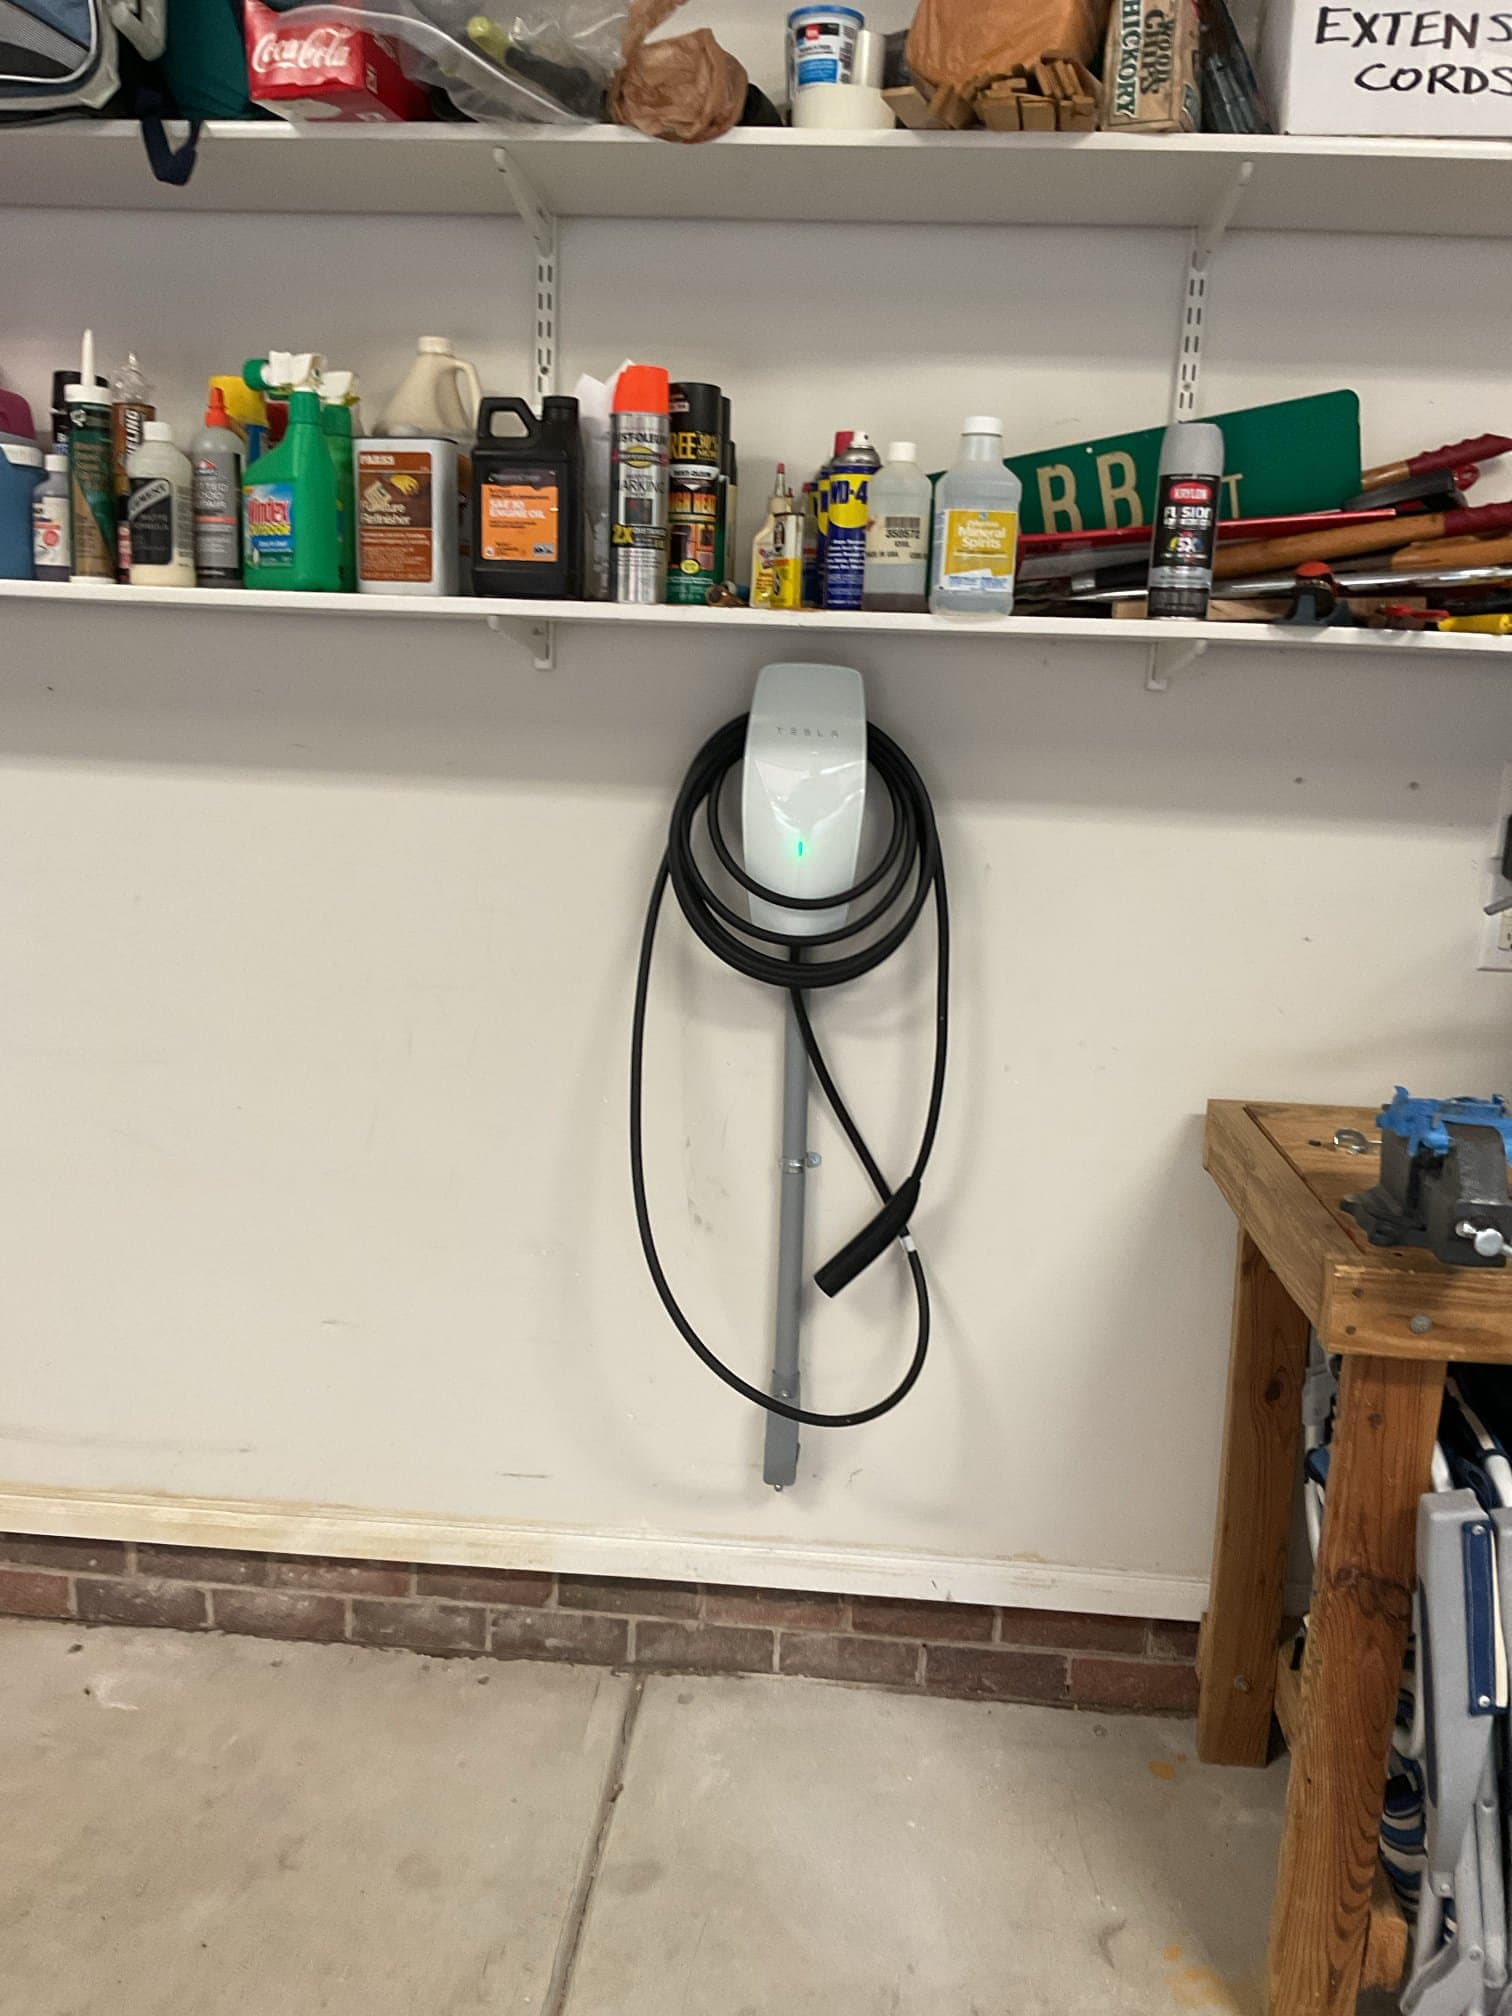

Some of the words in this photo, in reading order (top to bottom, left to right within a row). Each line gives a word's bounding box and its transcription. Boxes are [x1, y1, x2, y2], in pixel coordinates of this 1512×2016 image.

[252, 28, 352, 73] Coca-Cola
[1116, 0, 1141, 115] HICKORY
[1354, 63, 1512, 95] CORDS
[830, 480, 868, 505] WD-4
[958, 526, 1006, 540] Mineral
[961, 538, 1002, 550] Spirits
[776, 726, 840, 738] TESLA
